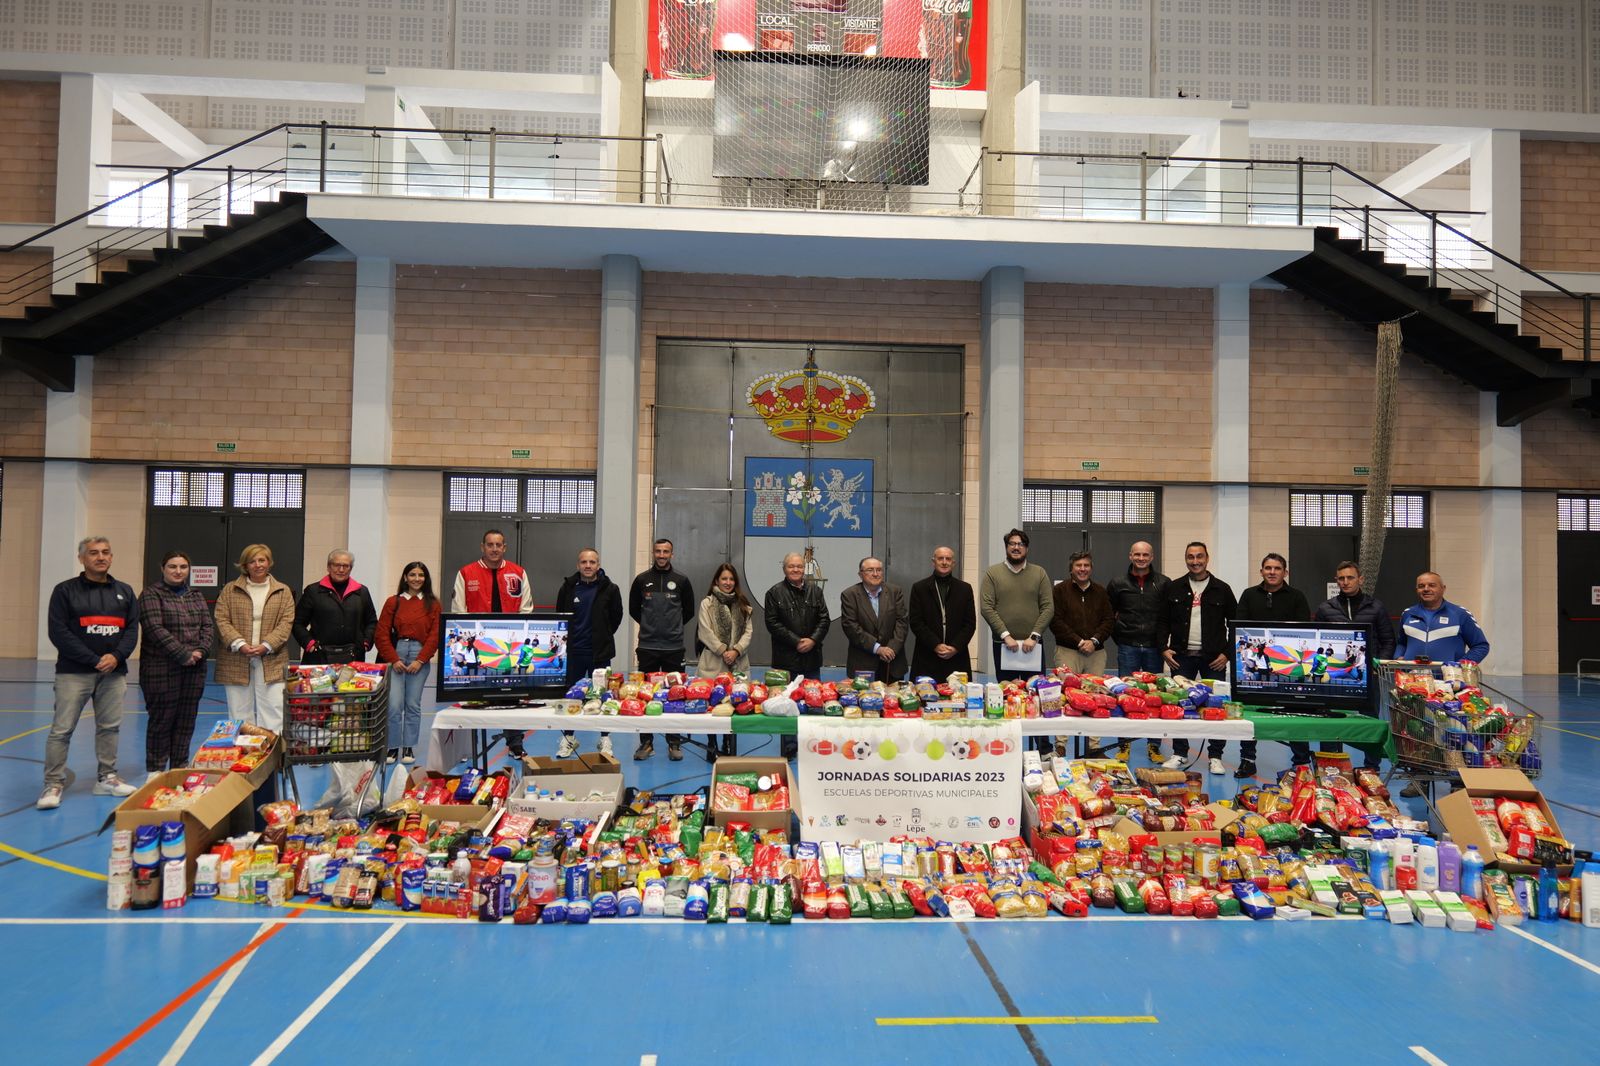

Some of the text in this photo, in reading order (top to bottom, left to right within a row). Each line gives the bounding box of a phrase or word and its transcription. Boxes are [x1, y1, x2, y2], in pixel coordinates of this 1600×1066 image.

[760, 15, 794, 25] LOCAL
[843, 18, 878, 29] VISITANTE
[503, 573, 522, 598] D
[86, 624, 120, 636] Kappa
[817, 771, 1005, 782] JORNADAS SOLIDARIAS 2023
[823, 788, 998, 798] ESCUELAS DEPORTIVAS MUNICIPALES
[906, 825, 926, 834] Lepe
